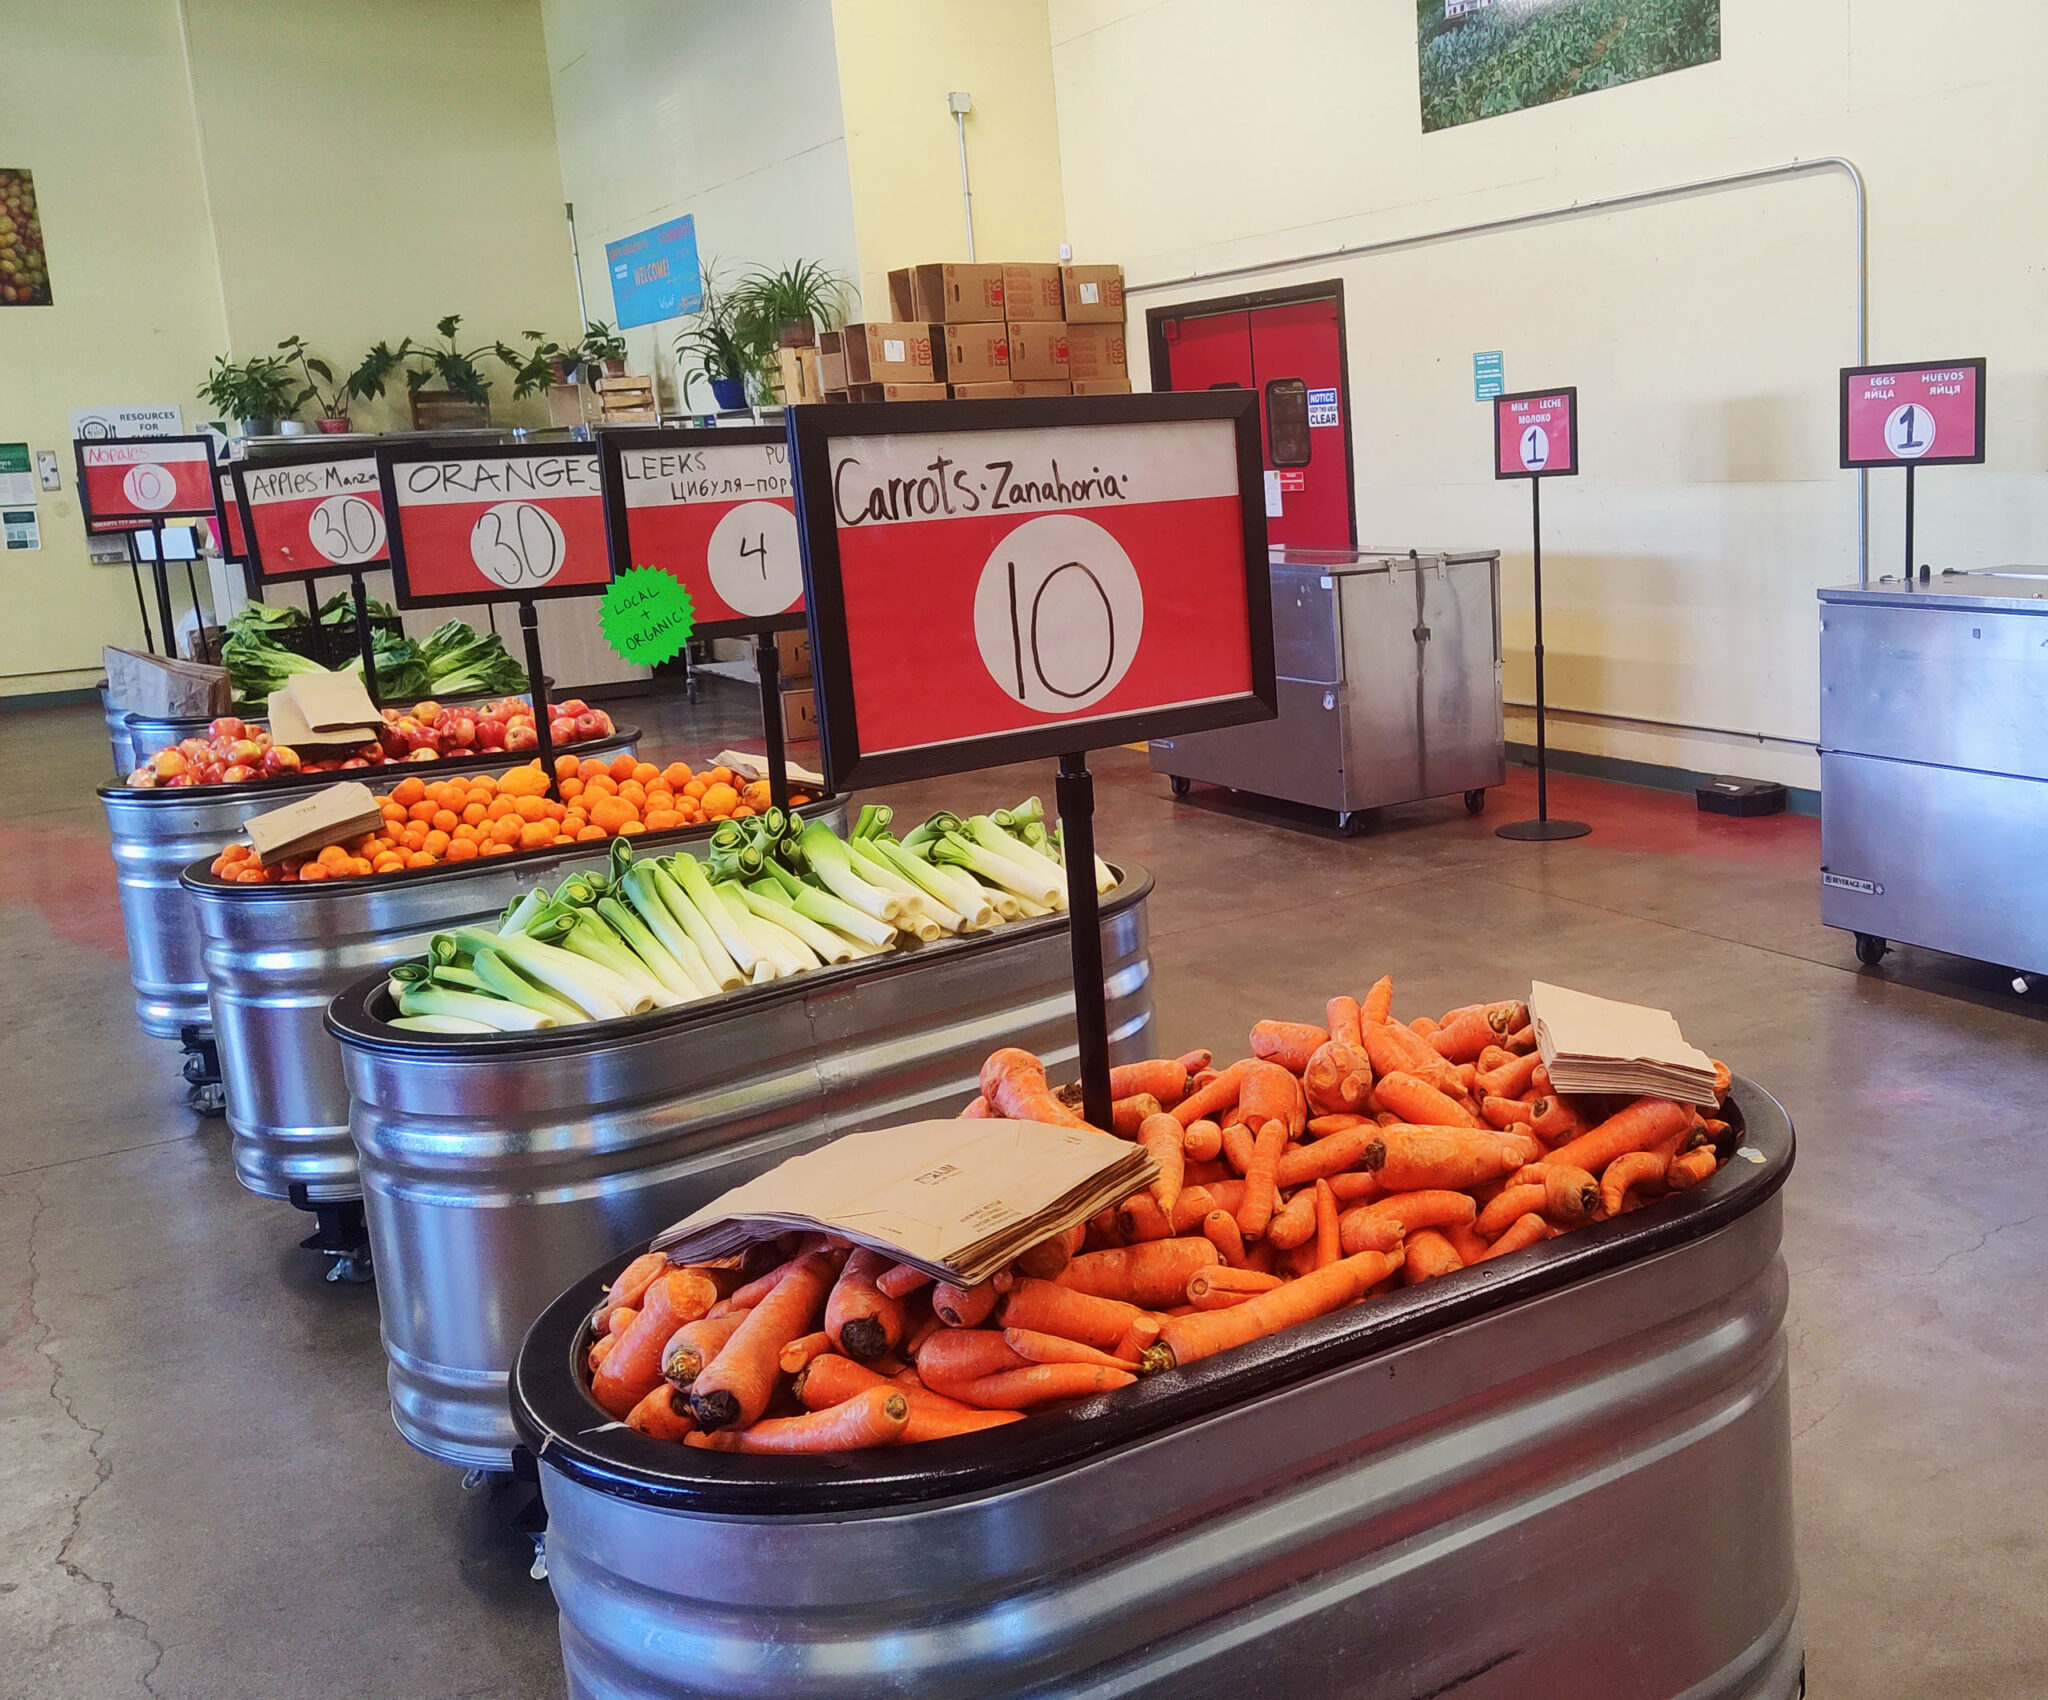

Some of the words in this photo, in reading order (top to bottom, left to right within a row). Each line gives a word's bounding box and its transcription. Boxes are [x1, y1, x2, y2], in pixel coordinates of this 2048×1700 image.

[916, 337, 932, 366] EGGS
[1870, 376, 1896, 387] EGGS
[1921, 371, 1965, 383] HUEVOS
[1929, 383, 1961, 396] ЯЙЦЯ
[1310, 392, 1336, 404] NOTICE
[1511, 402, 1529, 412] MILK
[1540, 398, 1562, 409] LECHE
[1864, 387, 1895, 400] ЯЙЦА
[120, 411, 175, 421] RESOURCES
[139, 423, 159, 431] FOR
[1310, 413, 1337, 425] CLEAR
[1518, 413, 1551, 424] МОЛОКО
[1897, 405, 1924, 449] 1
[1526, 429, 1545, 464] 1
[623, 451, 707, 480] LEEKS
[765, 445, 785, 465] PU
[131, 470, 161, 501] 10
[325, 466, 379, 490] Manza
[408, 459, 600, 493] ORANGES
[314, 498, 376, 559] 30
[477, 504, 557, 585] 30
[740, 532, 767, 580] 4
[613, 587, 661, 616] LOCAL
[1008, 560, 1115, 699] 10
